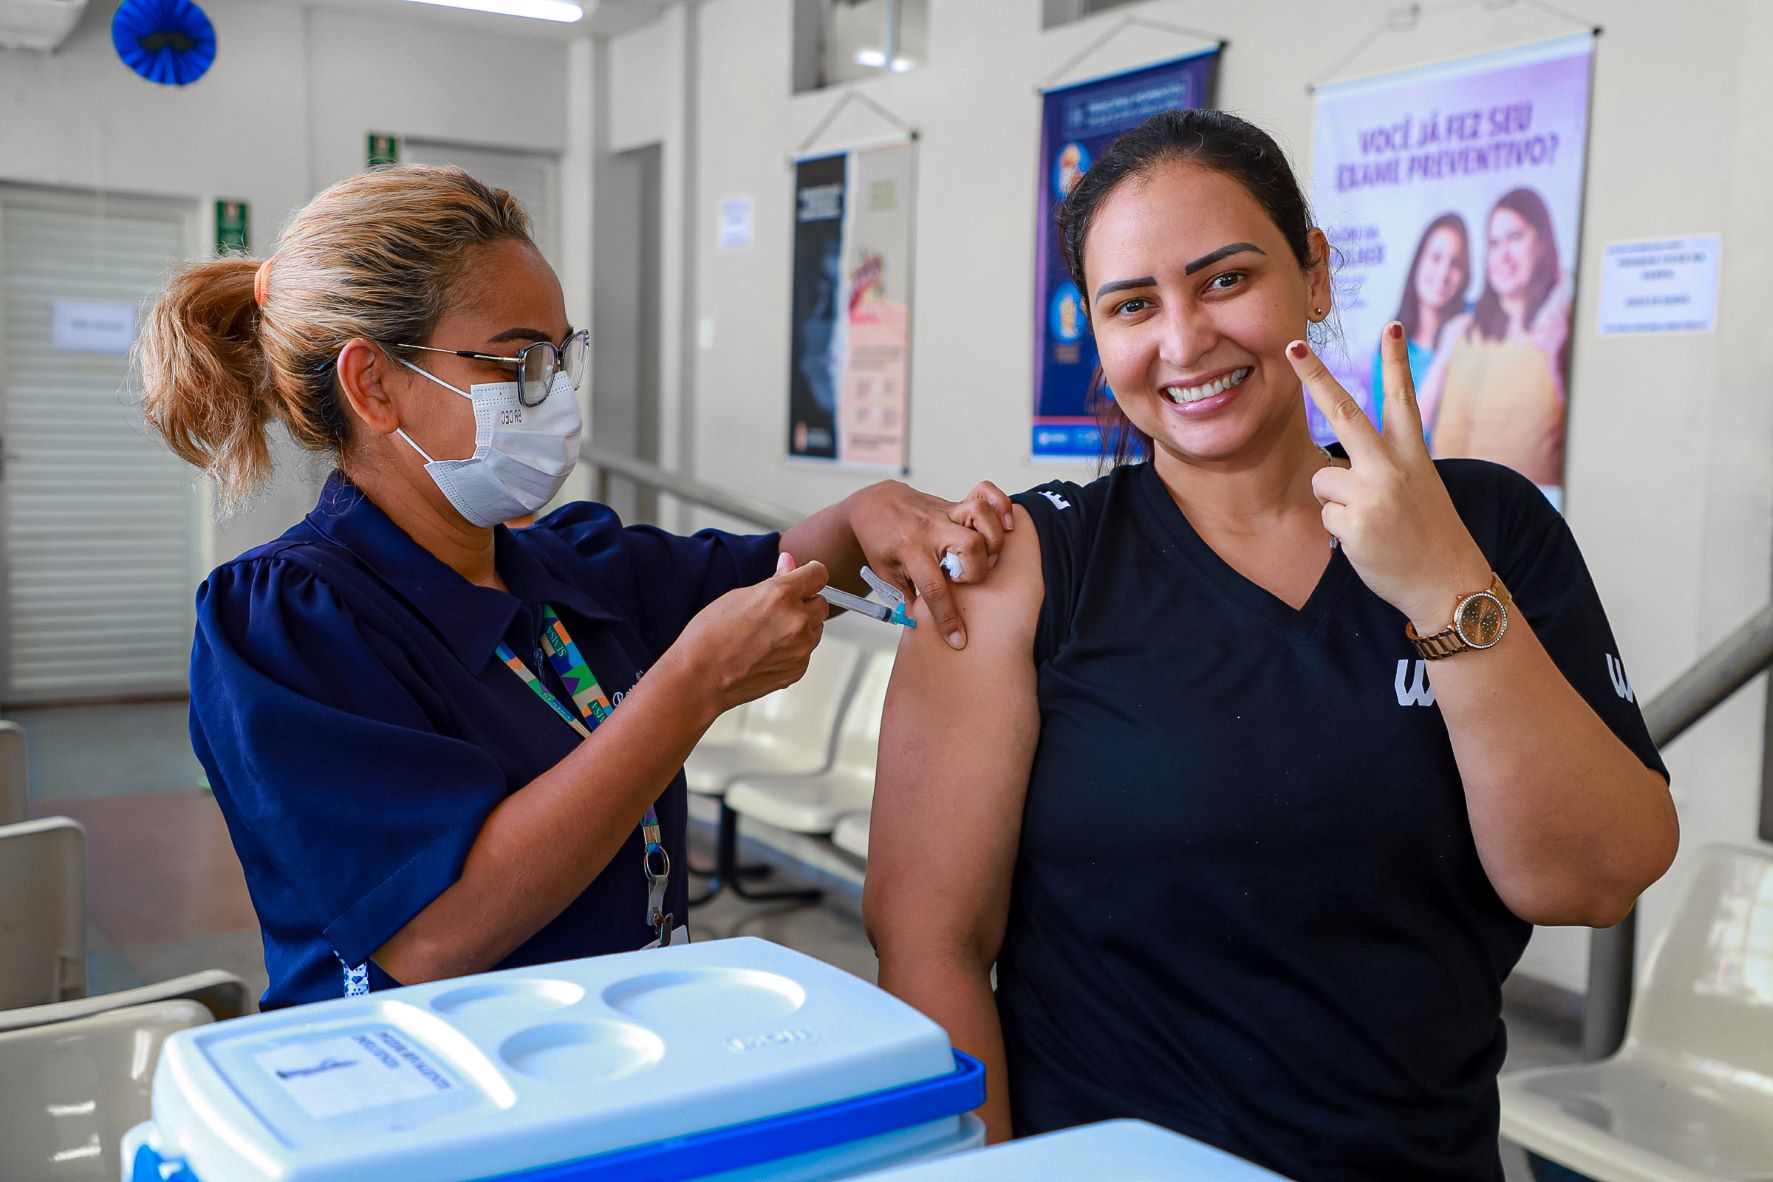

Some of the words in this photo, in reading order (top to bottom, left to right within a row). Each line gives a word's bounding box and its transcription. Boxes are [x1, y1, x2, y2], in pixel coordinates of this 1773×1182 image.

[1359, 113, 1411, 154] VOCÊ
[1418, 108, 1440, 146] JÁ
[1445, 109, 1482, 141] FEZ
[1488, 101, 1534, 135] SEU
[1335, 157, 1399, 193] EXAME
[1407, 131, 1560, 180] PREVENTIVO?
[546, 625, 567, 657] SEMSA
